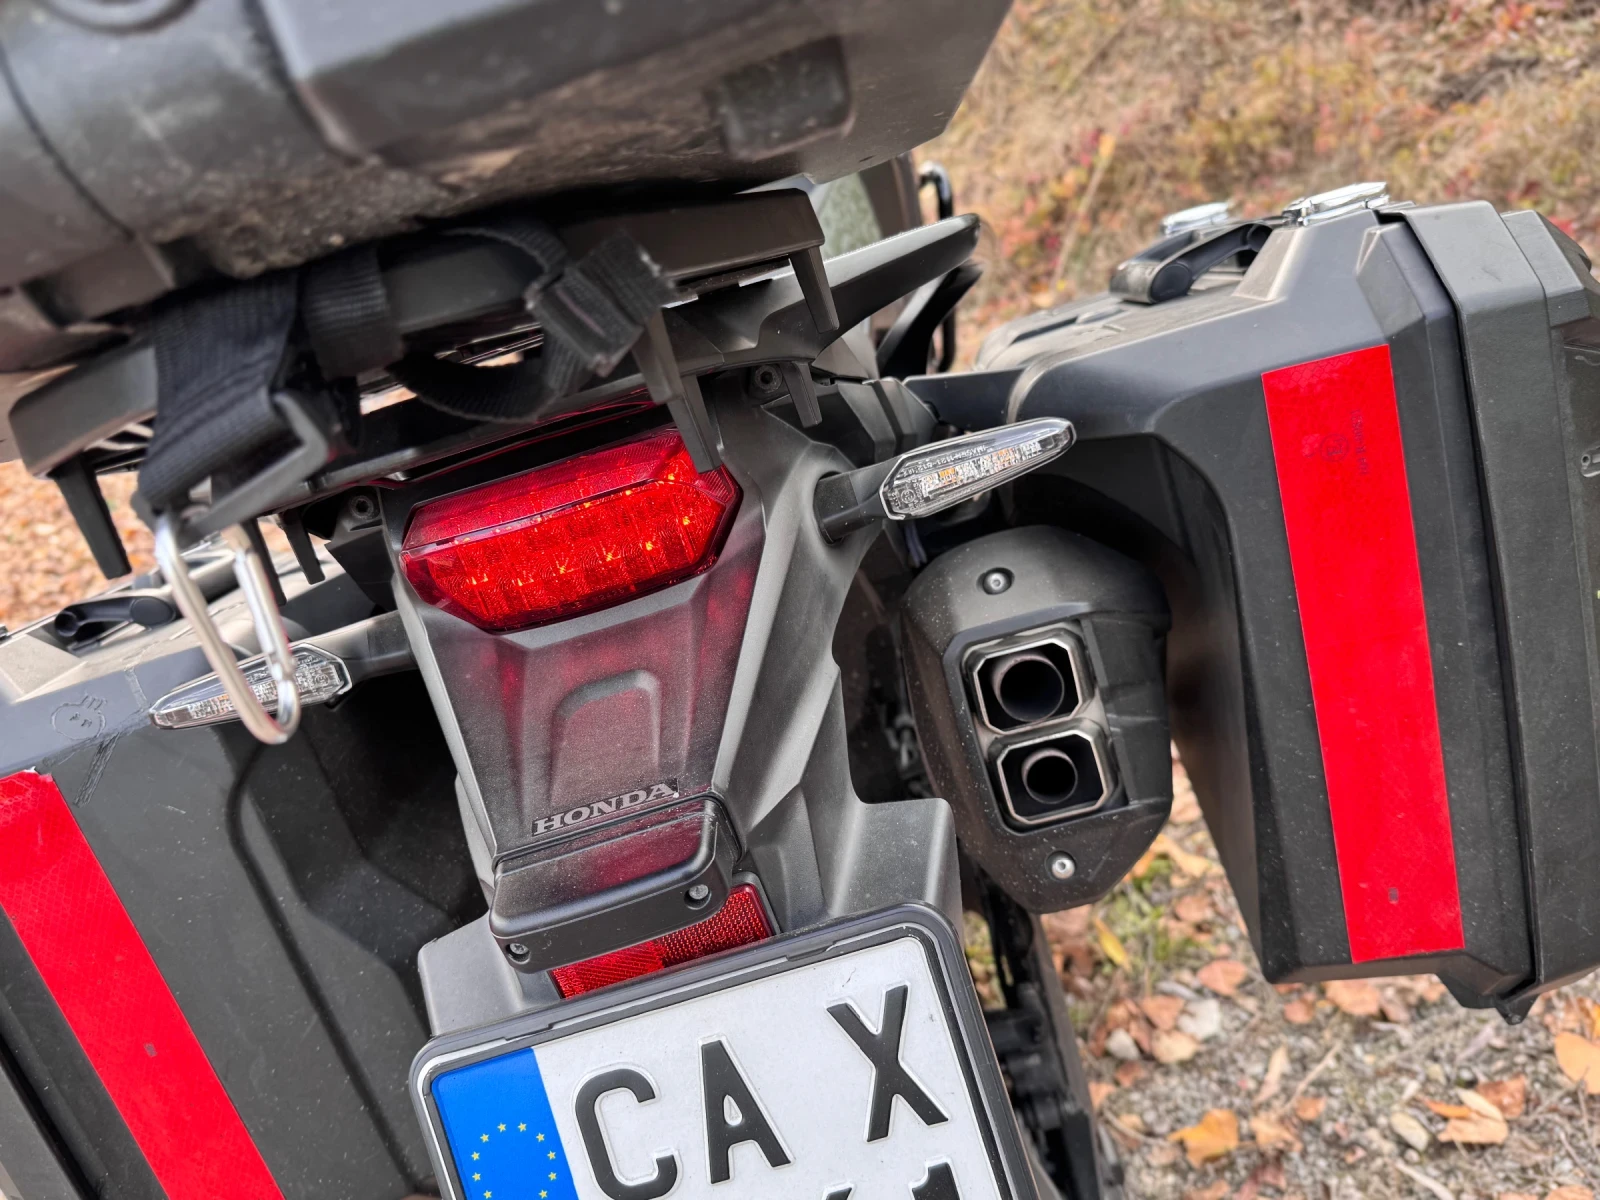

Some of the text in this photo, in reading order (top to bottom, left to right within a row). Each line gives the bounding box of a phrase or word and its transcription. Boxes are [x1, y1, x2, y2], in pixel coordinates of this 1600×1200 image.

[533, 782, 677, 836] HONDA
[575, 984, 949, 1200] CA X
